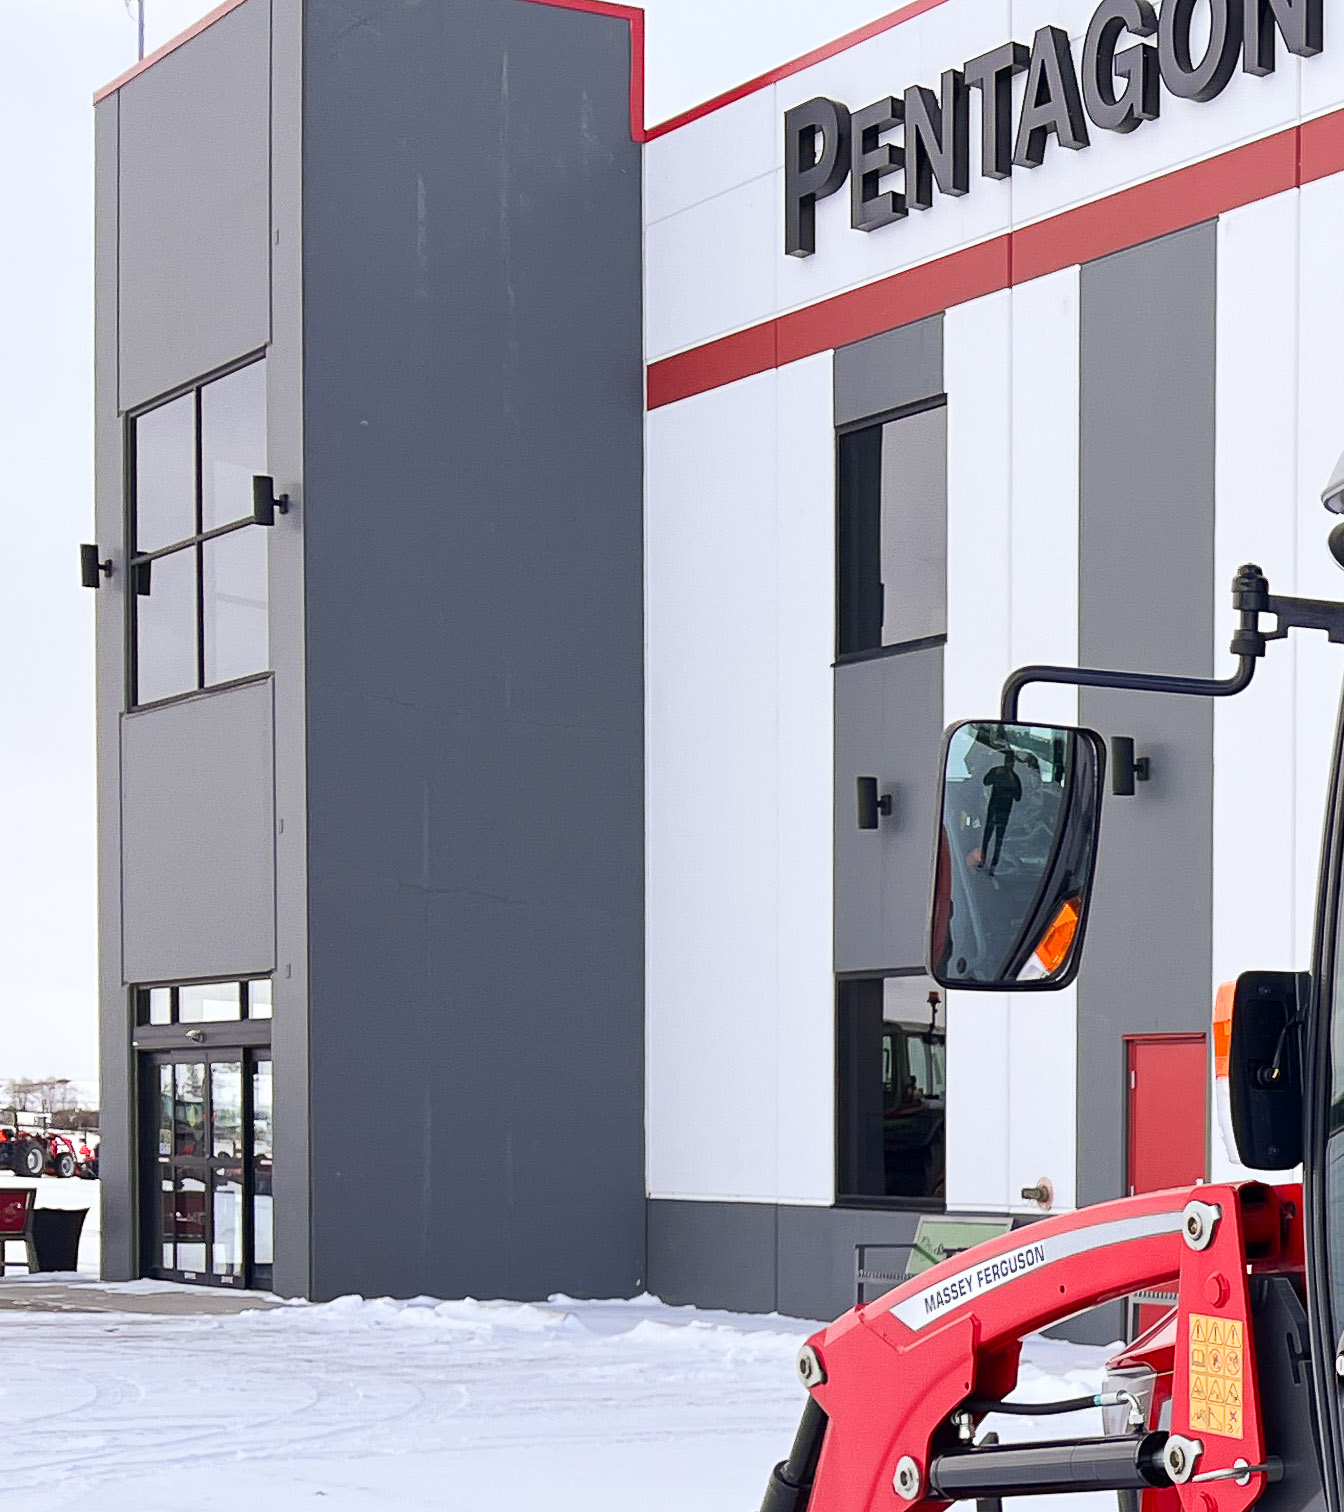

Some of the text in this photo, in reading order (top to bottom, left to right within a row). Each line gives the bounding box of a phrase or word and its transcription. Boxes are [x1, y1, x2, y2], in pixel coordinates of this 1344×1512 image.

[784, 0, 1324, 258] PENTAGON
[924, 1244, 1046, 1315] MASSEY FERGUSON
